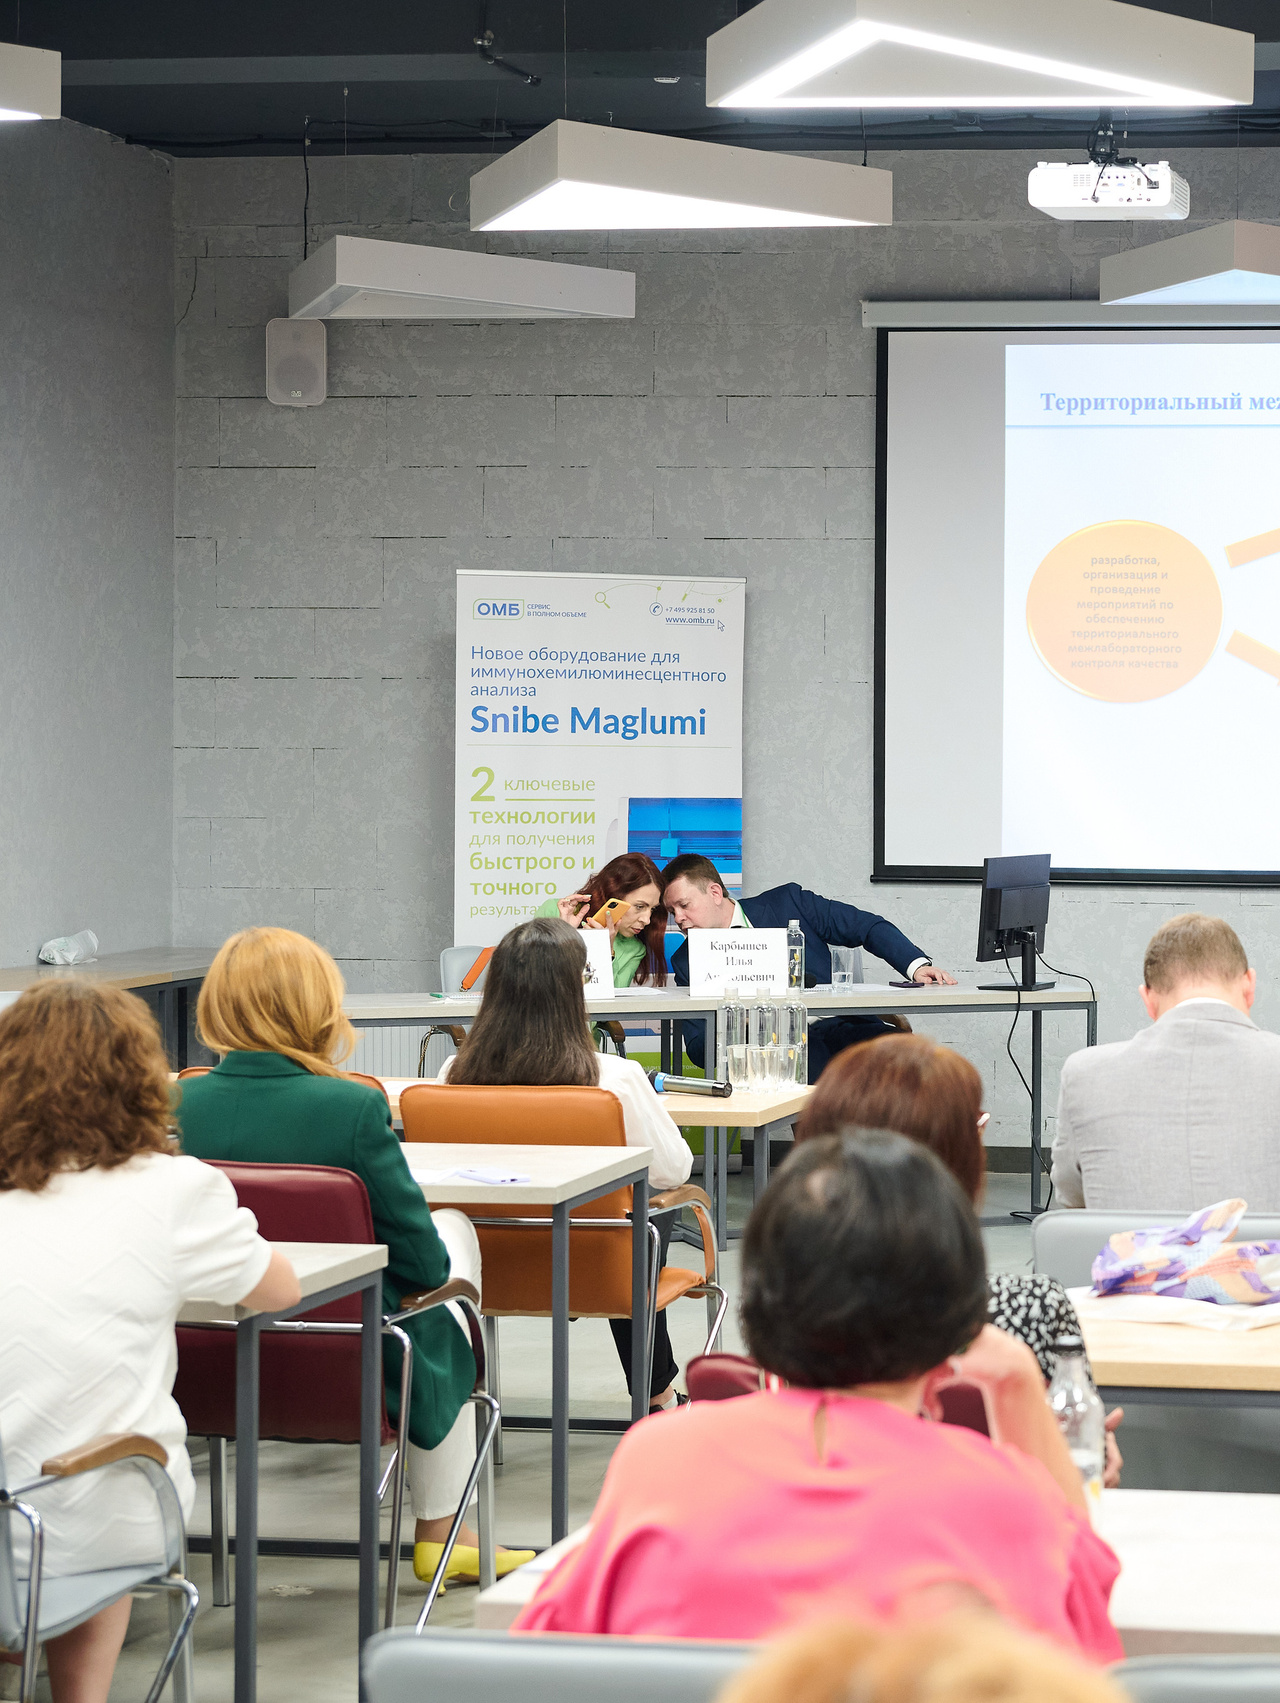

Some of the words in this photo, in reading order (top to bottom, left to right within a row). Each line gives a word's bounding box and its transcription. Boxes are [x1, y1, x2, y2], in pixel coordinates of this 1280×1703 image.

[1041, 392, 1243, 415] Территориальный
[1091, 555, 1161, 567] разработка,
[1083, 572, 1158, 581] организация
[1090, 586, 1161, 596] проведение
[477, 602, 520, 616] ОМБ
[1077, 600, 1156, 611] мероприятий
[665, 616, 715, 624] www.omb.ru
[1085, 614, 1165, 624] обеспечению
[1071, 630, 1179, 641] территориального
[1068, 643, 1182, 655] межлабораторного
[471, 646, 524, 660] Новое
[528, 647, 647, 664] оборудование
[650, 651, 681, 666] для
[1070, 660, 1125, 670] контроля
[1128, 661, 1179, 669] качества
[470, 667, 727, 683] иммунохемилюминесцентного
[470, 684, 537, 697] анализа
[470, 705, 559, 734] Snibe
[570, 707, 707, 740] Maglumi
[470, 766, 496, 802] 2
[504, 779, 596, 791] ключевые
[469, 811, 596, 824] технологии
[469, 834, 501, 848] для
[506, 832, 595, 848] получения
[470, 852, 576, 873] быстрого
[583, 857, 595, 870] и
[470, 882, 557, 895] точного
[470, 903, 538, 918] результа
[710, 941, 768, 953] Карбышев
[726, 957, 753, 966] Илья
